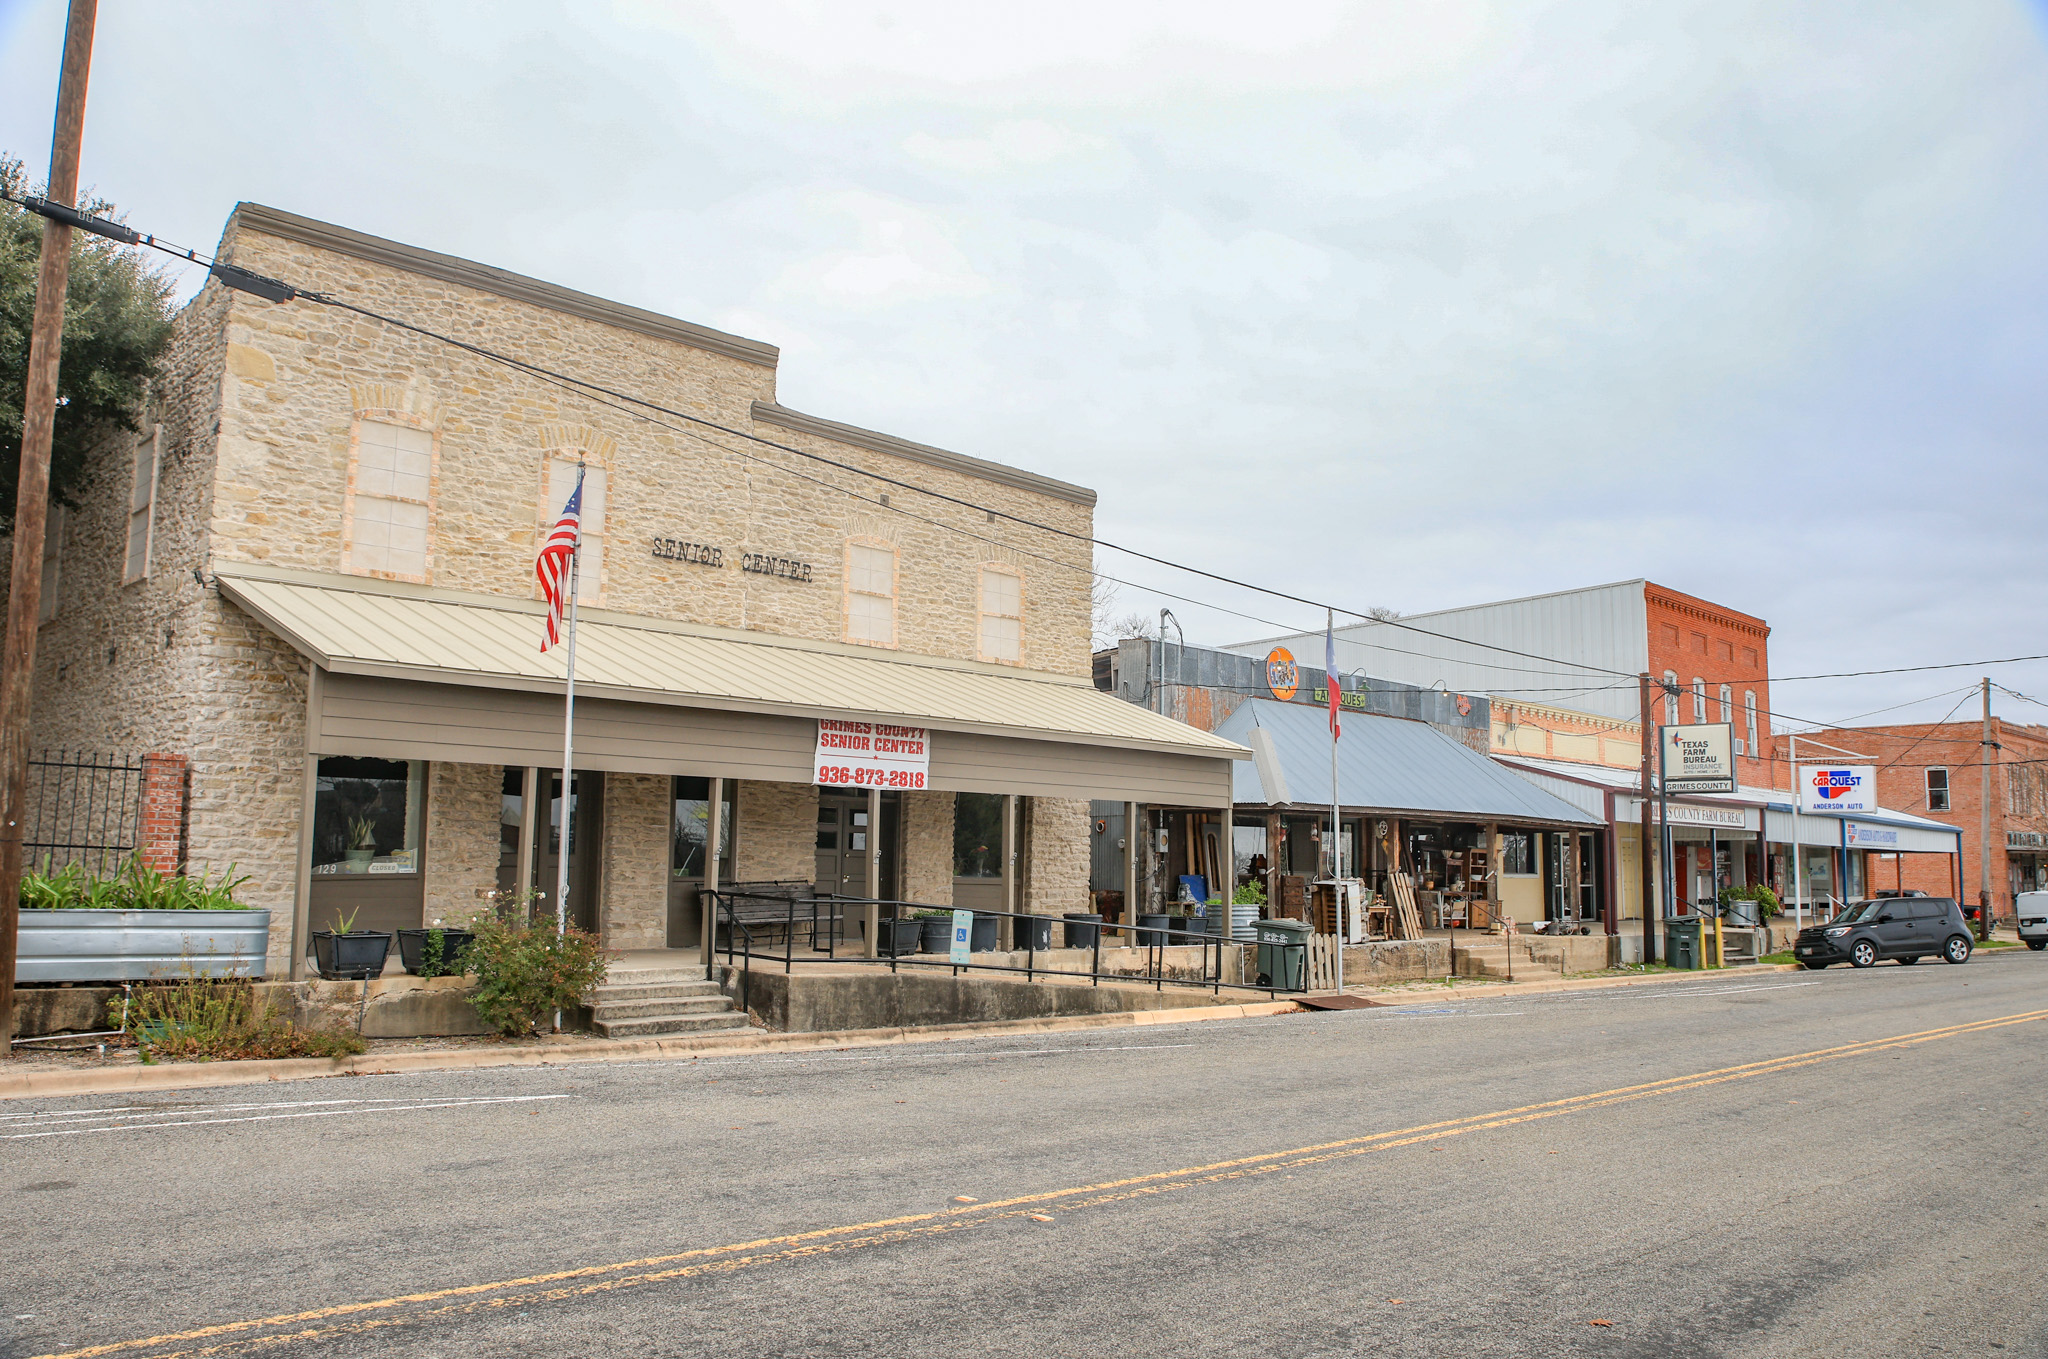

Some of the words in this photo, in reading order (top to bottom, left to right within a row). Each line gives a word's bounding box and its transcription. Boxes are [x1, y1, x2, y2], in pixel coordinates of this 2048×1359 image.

[652, 537, 723, 568] SENIOR
[742, 553, 813, 583] CENTER
[1320, 691, 1361, 706] AQUES
[820, 719, 871, 734] GRIMES
[875, 724, 925, 739] COUNTY
[821, 733, 870, 750] SENIOR
[874, 738, 924, 755] CENTER
[819, 766, 925, 788] 936-873-2818
[1812, 777, 1861, 786] CARQUEST
[1674, 807, 1700, 820] COUNTY
[1702, 809, 1718, 822] FARM
[1720, 811, 1743, 824] BUREAU
[319, 864, 337, 874] 129
